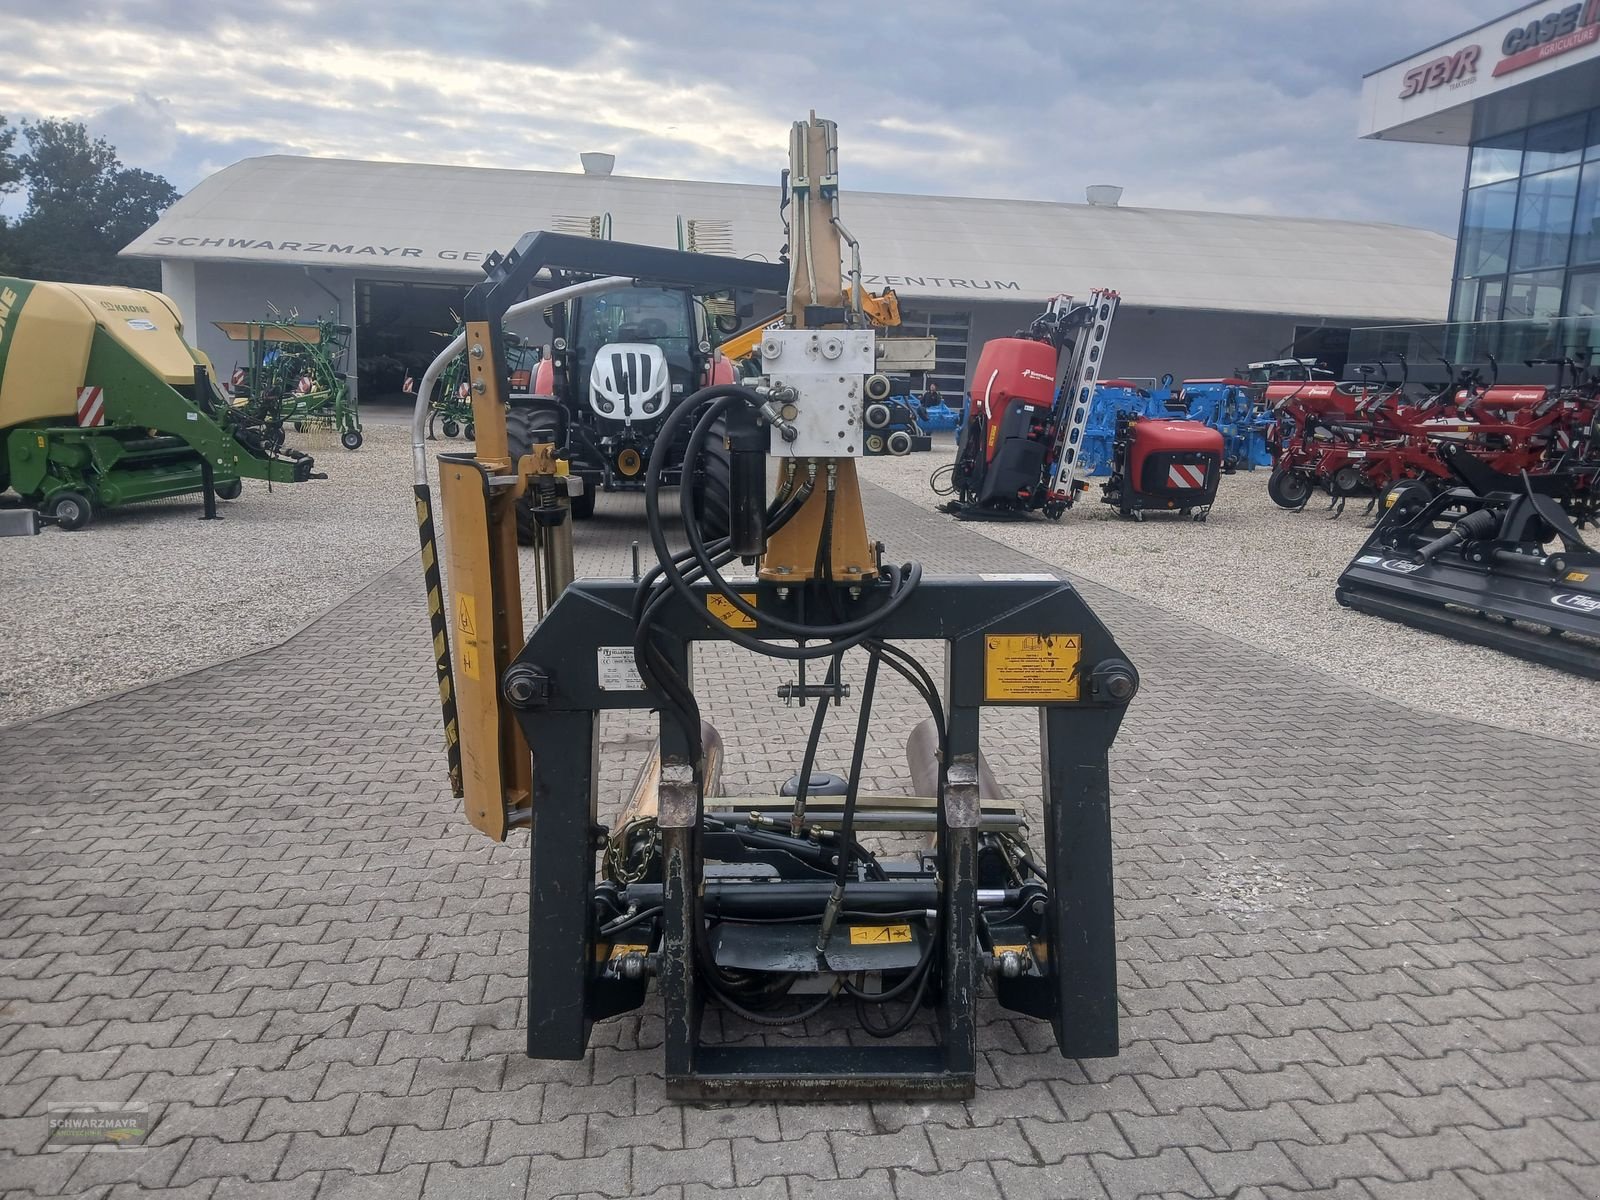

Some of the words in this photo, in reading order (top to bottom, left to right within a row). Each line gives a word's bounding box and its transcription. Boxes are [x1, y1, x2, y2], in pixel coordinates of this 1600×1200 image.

[1501, 3, 1582, 56] CASE
[1539, 28, 1593, 57] AGRICULTURE
[1399, 44, 1480, 99] STEYR
[153, 236, 423, 258] SCHWARZMAYR
[114, 303, 150, 314] KRONE
